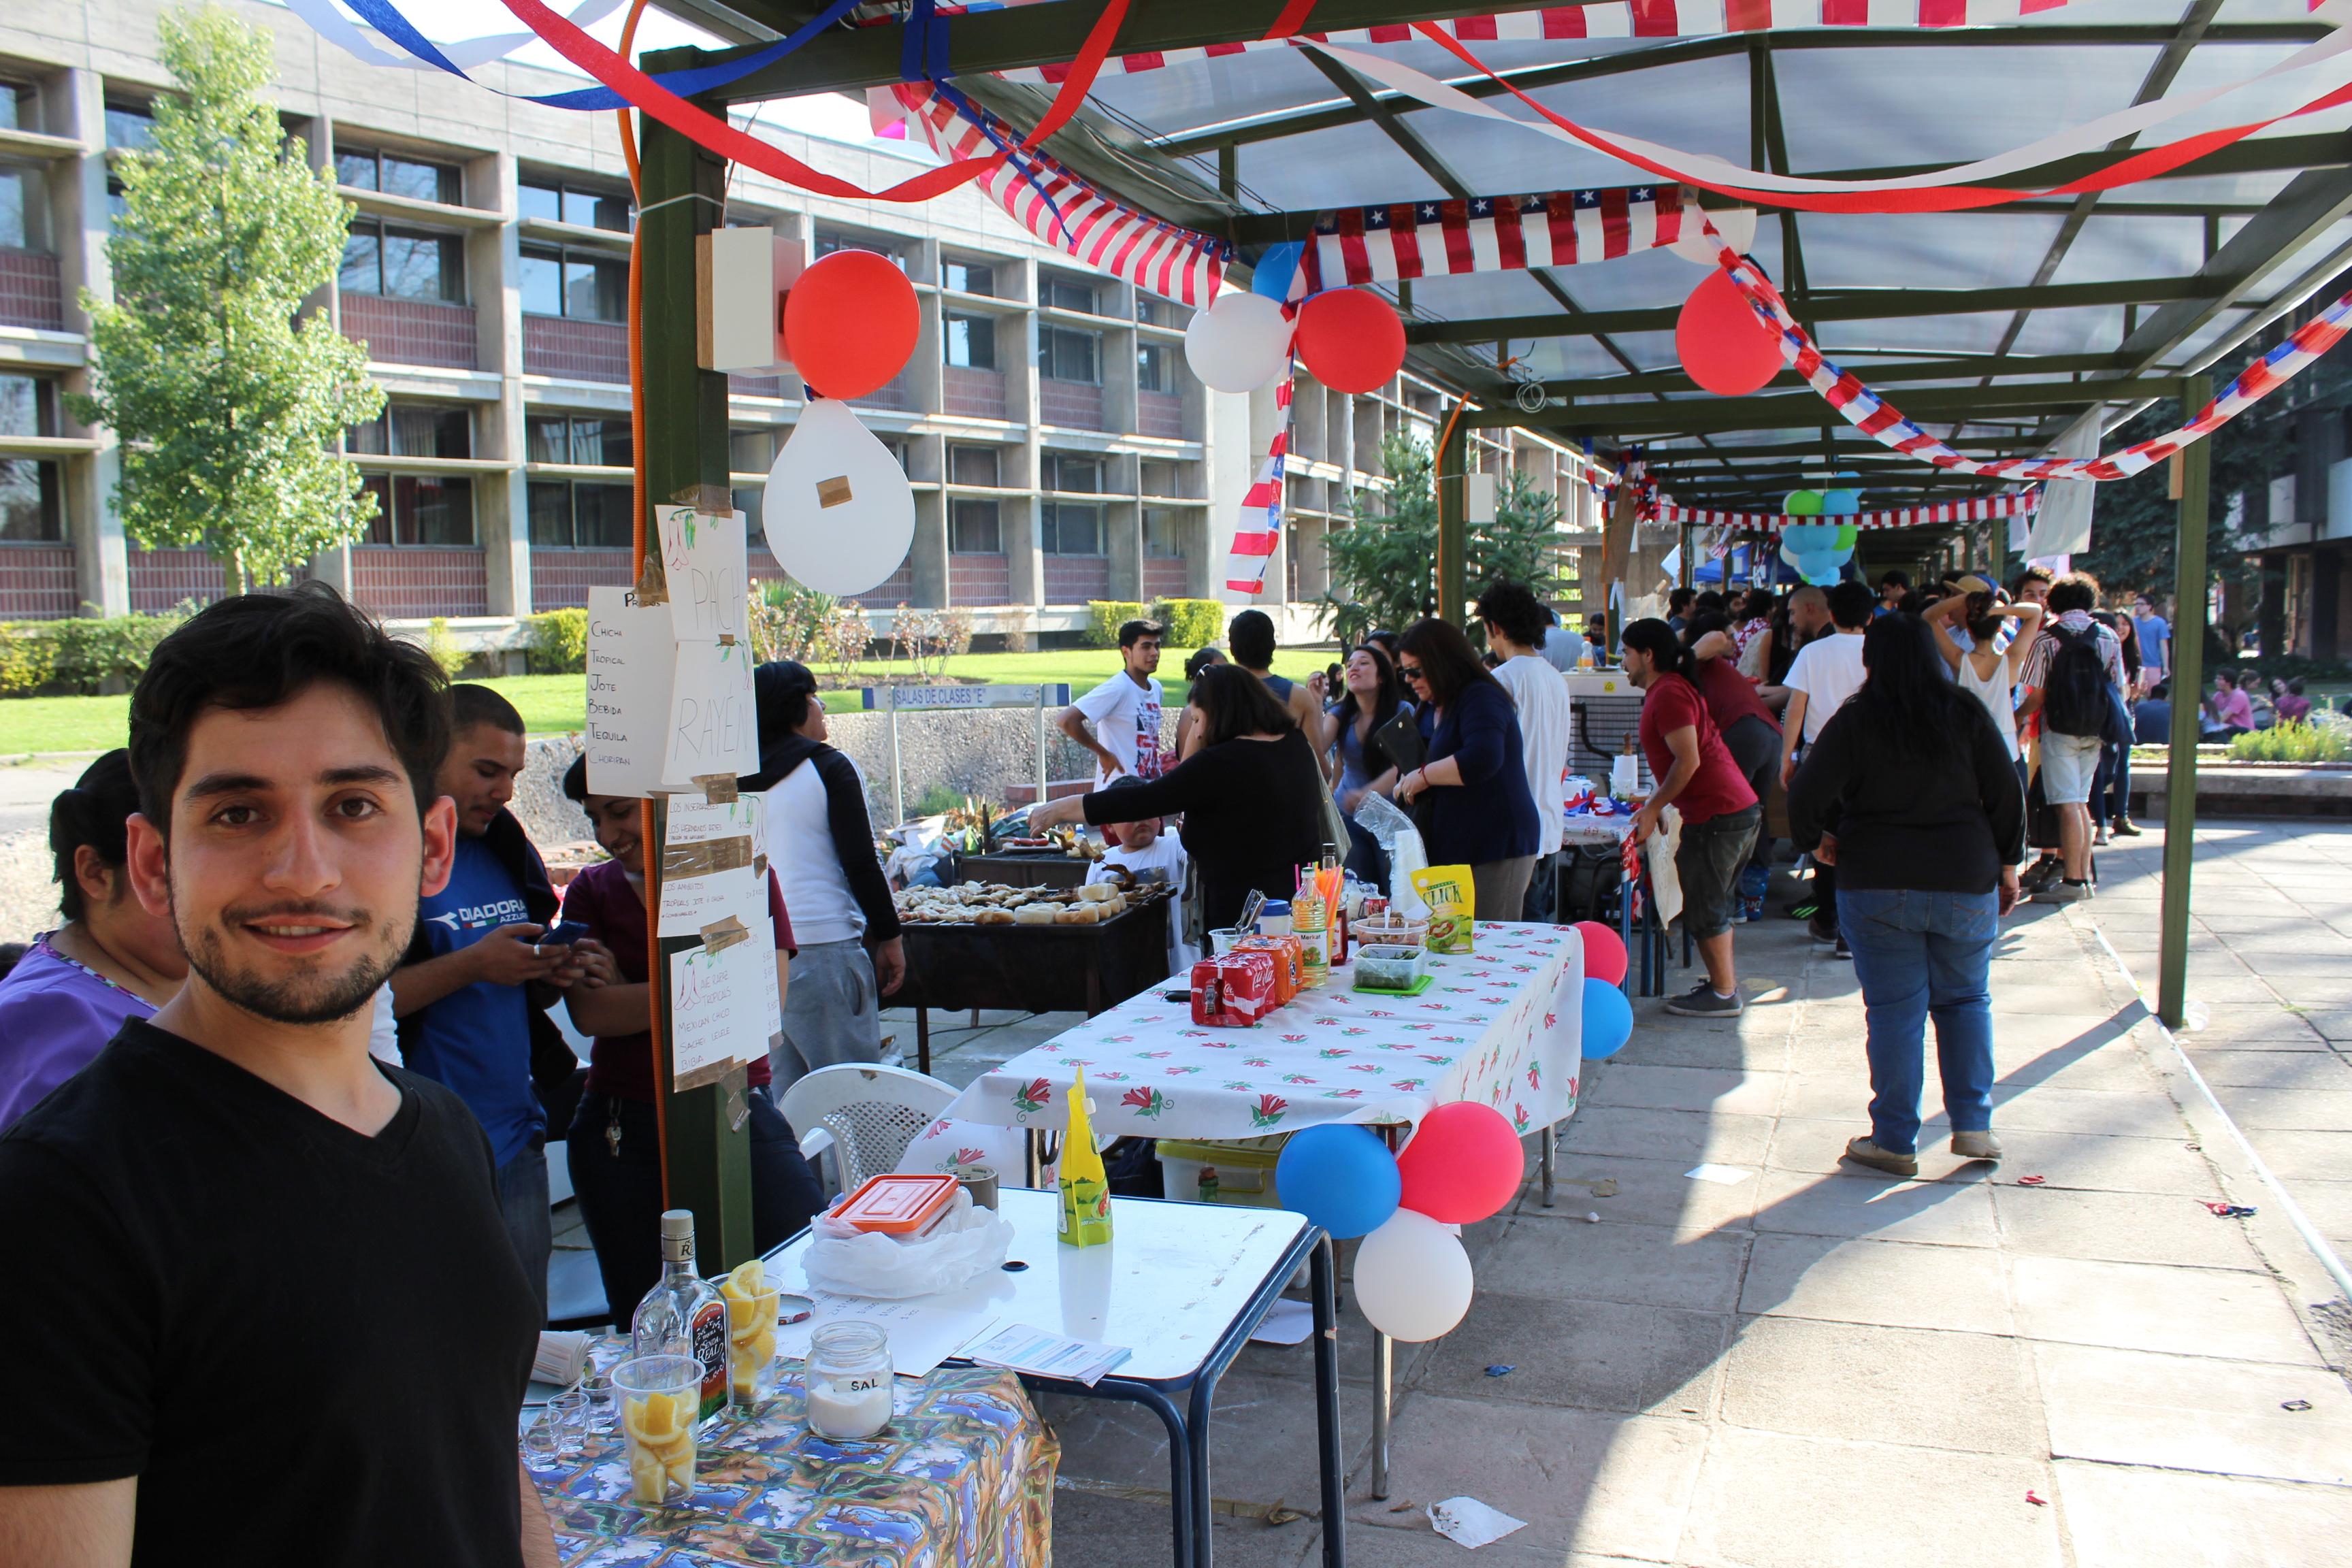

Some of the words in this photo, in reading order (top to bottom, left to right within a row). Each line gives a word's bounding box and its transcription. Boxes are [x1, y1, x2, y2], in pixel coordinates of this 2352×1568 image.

[591, 621, 622, 637] CHICHA
[590, 649, 625, 664] TROPICAL
[590, 674, 617, 691] JOTE
[896, 689, 923, 705] SALAS
[926, 689, 936, 704] DE
[938, 688, 971, 704] CLASES
[973, 687, 986, 703] "E"
[588, 698, 622, 715] BEBIDA
[589, 722, 627, 742] TEQUILA
[588, 747, 630, 766] CHORIPAN
[670, 802, 681, 813] LOS
[668, 822, 679, 834] LOS
[664, 883, 675, 892] LOS
[459, 899, 525, 921] DIADORA
[698, 1343, 723, 1363] REAL
[851, 1378, 878, 1391] SAL
